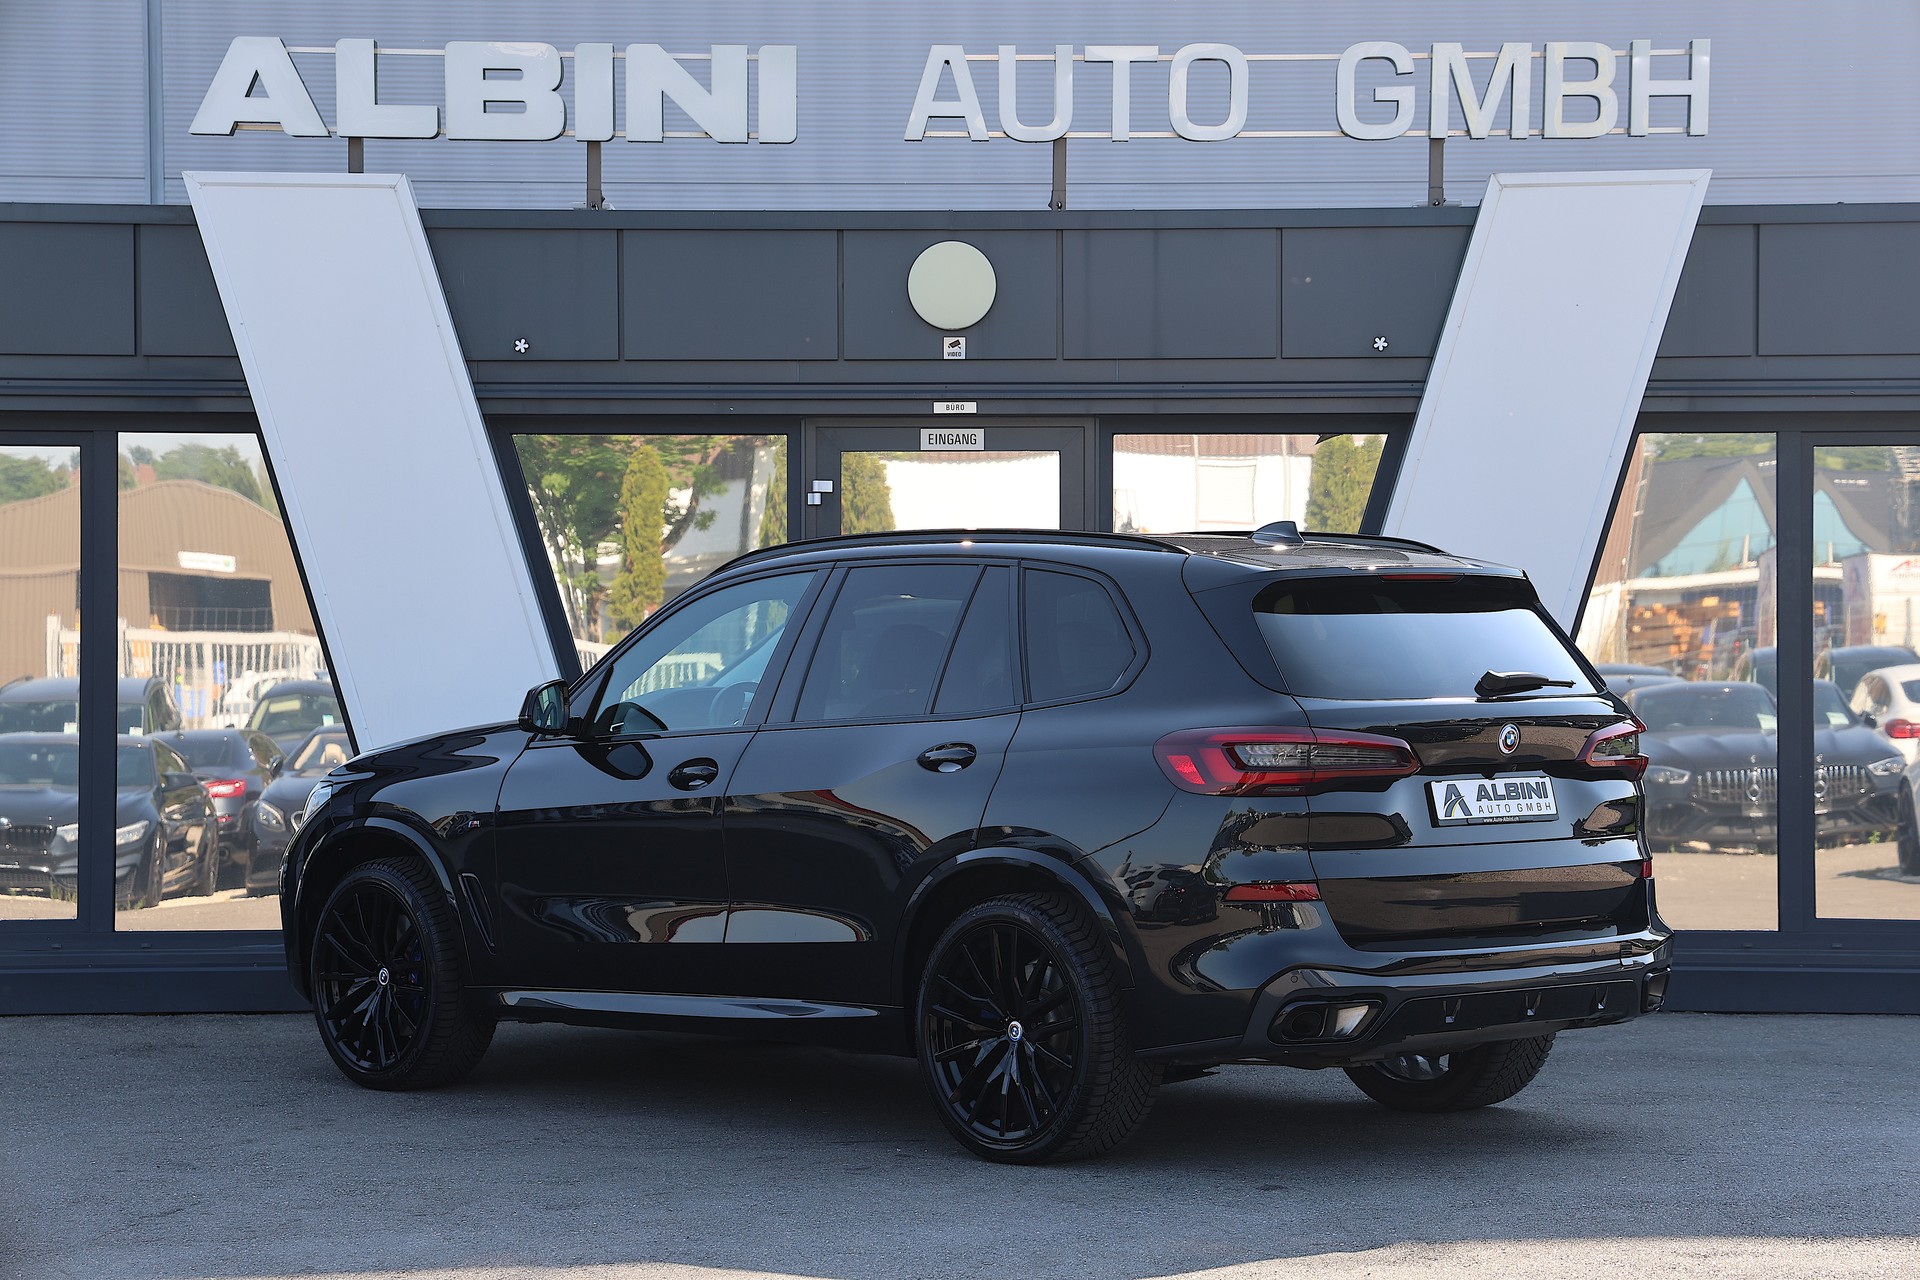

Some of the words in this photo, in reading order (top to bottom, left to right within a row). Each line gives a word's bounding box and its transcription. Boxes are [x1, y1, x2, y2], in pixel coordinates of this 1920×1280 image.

[188, 36, 798, 144] ALBINI
[904, 42, 1250, 143] AUTO
[1335, 38, 1712, 141] GMBH
[945, 403, 965, 411] BÜRO
[928, 433, 977, 445] EINGANG
[1476, 782, 1549, 801] ALBINI
[1478, 803, 1511, 814] AUTO
[1516, 802, 1552, 813] GMBH
